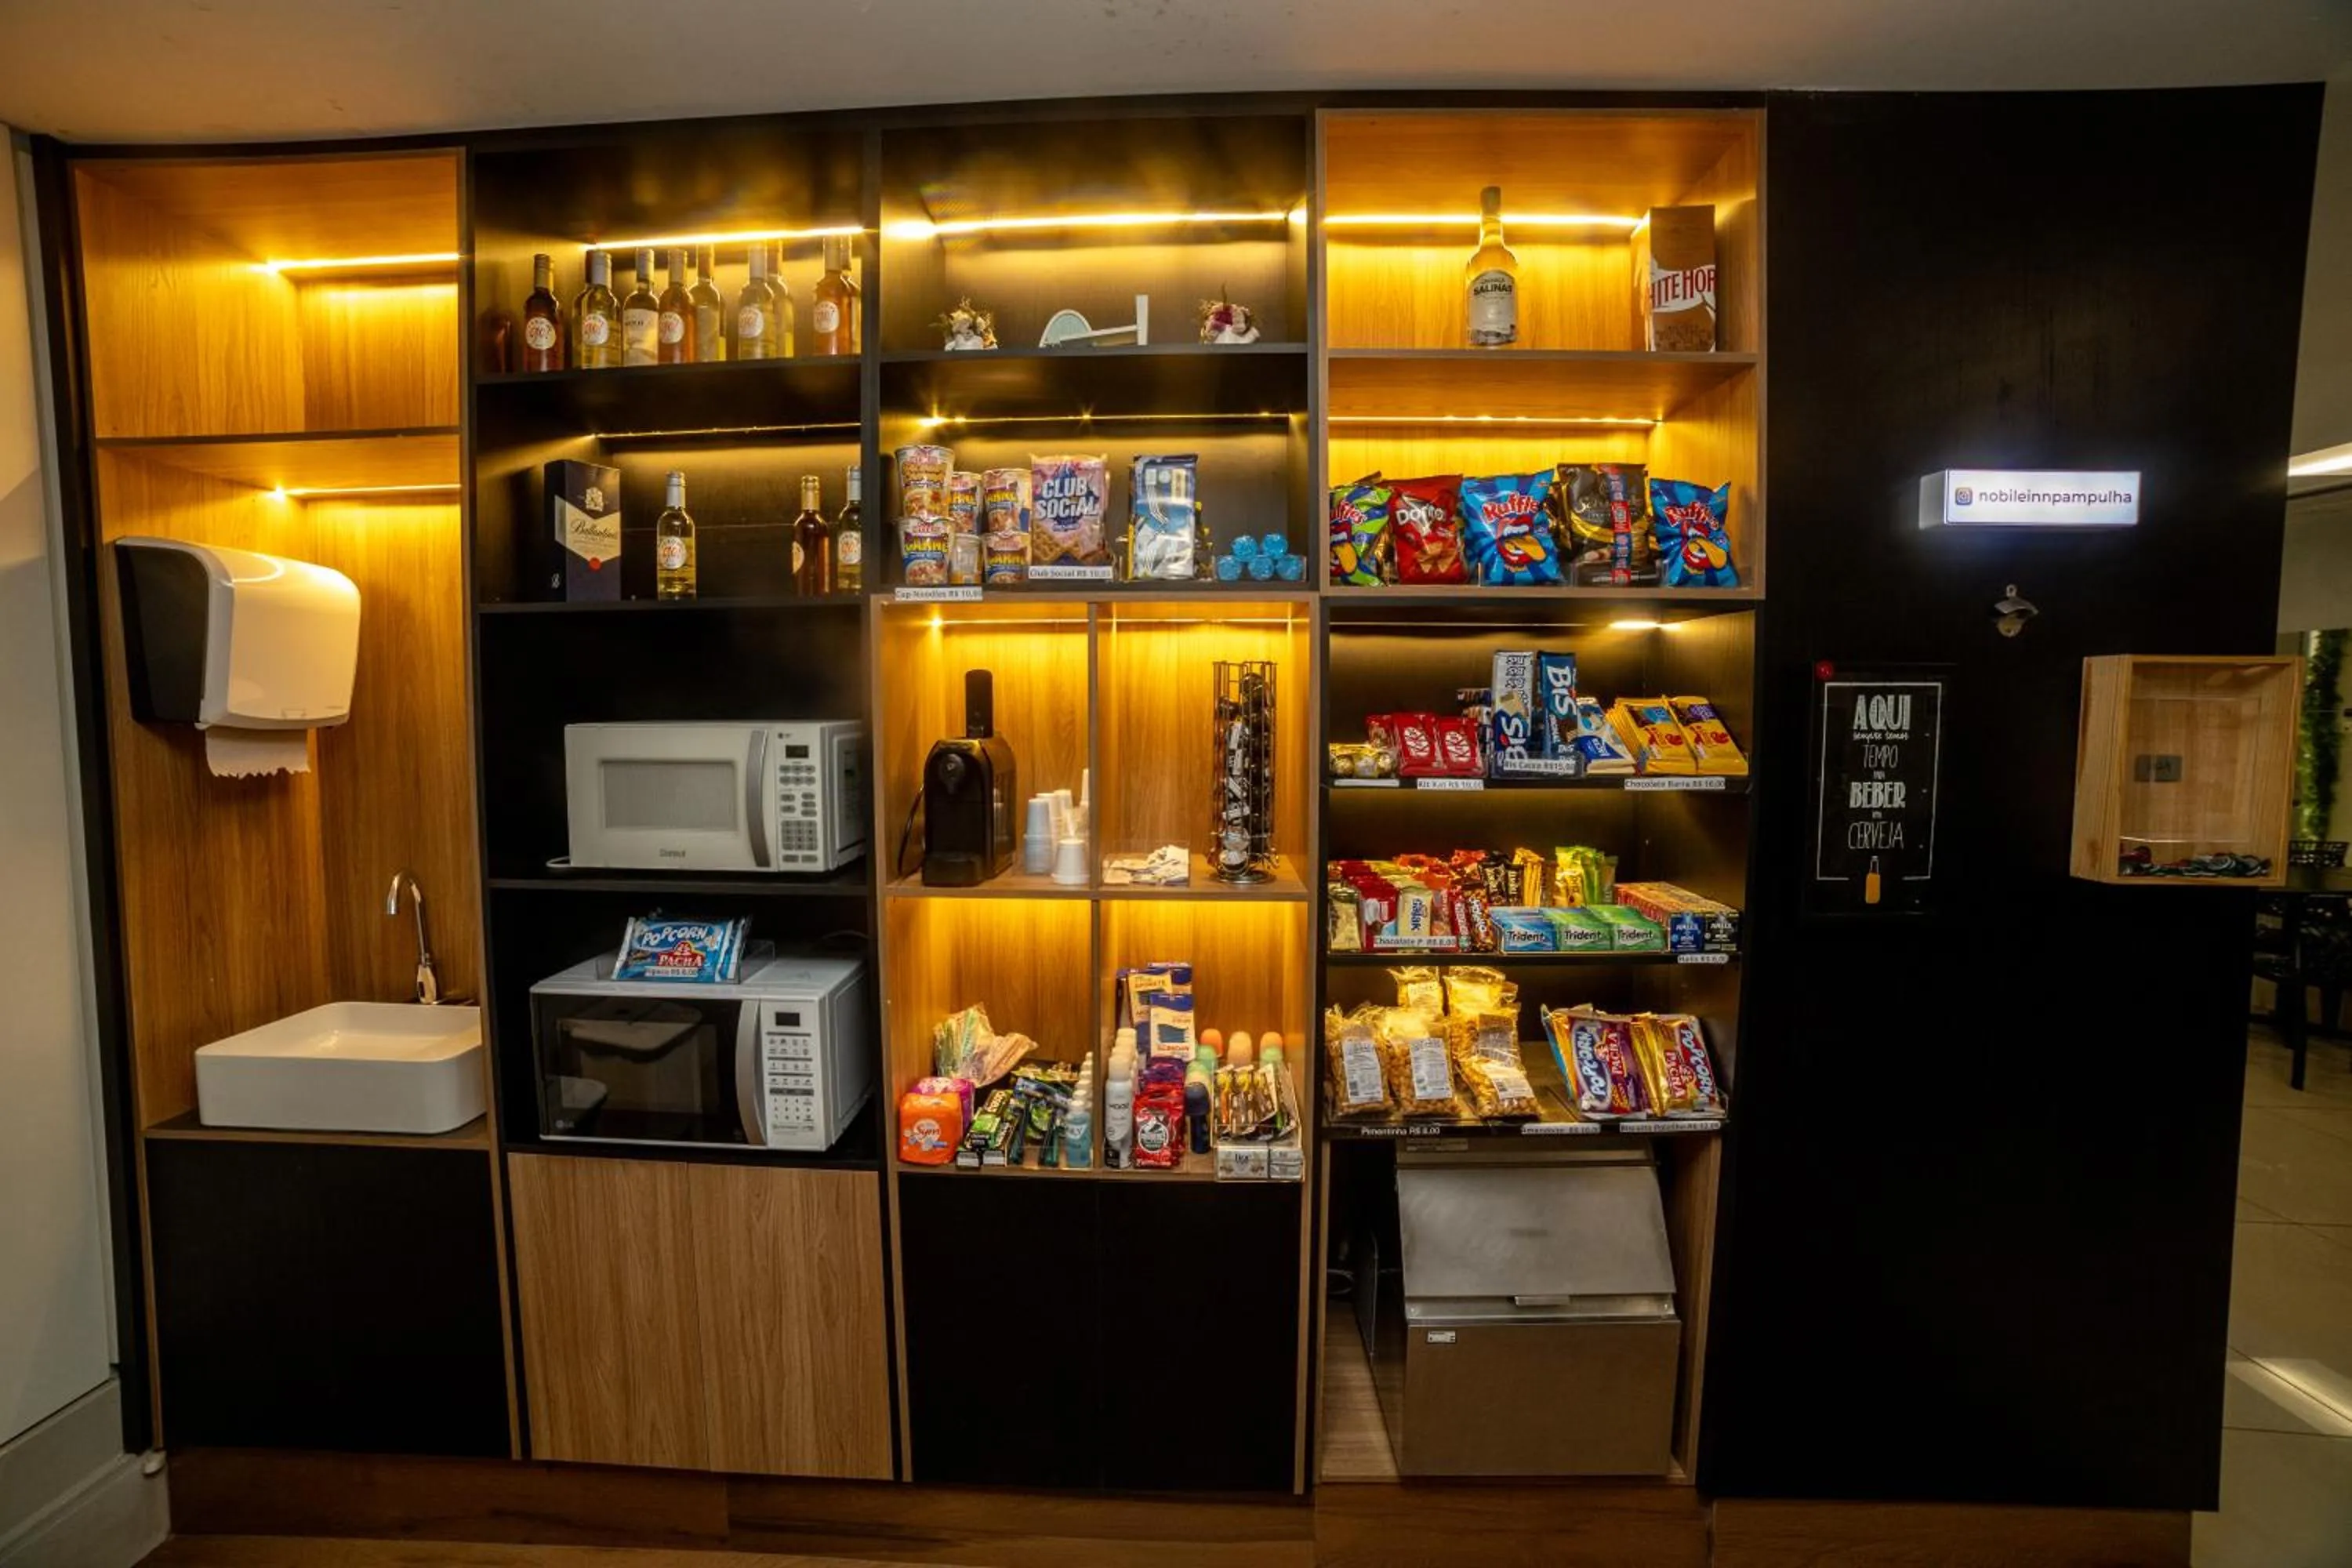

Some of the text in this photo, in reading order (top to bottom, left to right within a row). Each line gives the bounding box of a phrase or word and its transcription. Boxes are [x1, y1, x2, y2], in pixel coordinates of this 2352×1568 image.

[1474, 283, 1512, 296] SALINAS
[1042, 477, 1087, 499] CLUB
[1978, 488, 2132, 506] nobileinnpampulha
[1547, 665, 1577, 716] BIS
[1853, 694, 1911, 731] AQUI
[1501, 715, 1529, 761] BIS
[1862, 744, 1899, 768] TEMPO
[1849, 781, 1906, 809] BEBER
[1848, 820, 1905, 850] CERVEJA
[643, 926, 708, 946] POPCORN
[1506, 931, 1545, 942] Trident
[1564, 930, 1602, 941] Trident
[1617, 929, 1653, 940] Trident
[1575, 1029, 1606, 1097] POPCORN
[1679, 1029, 1713, 1095] POPCORN
